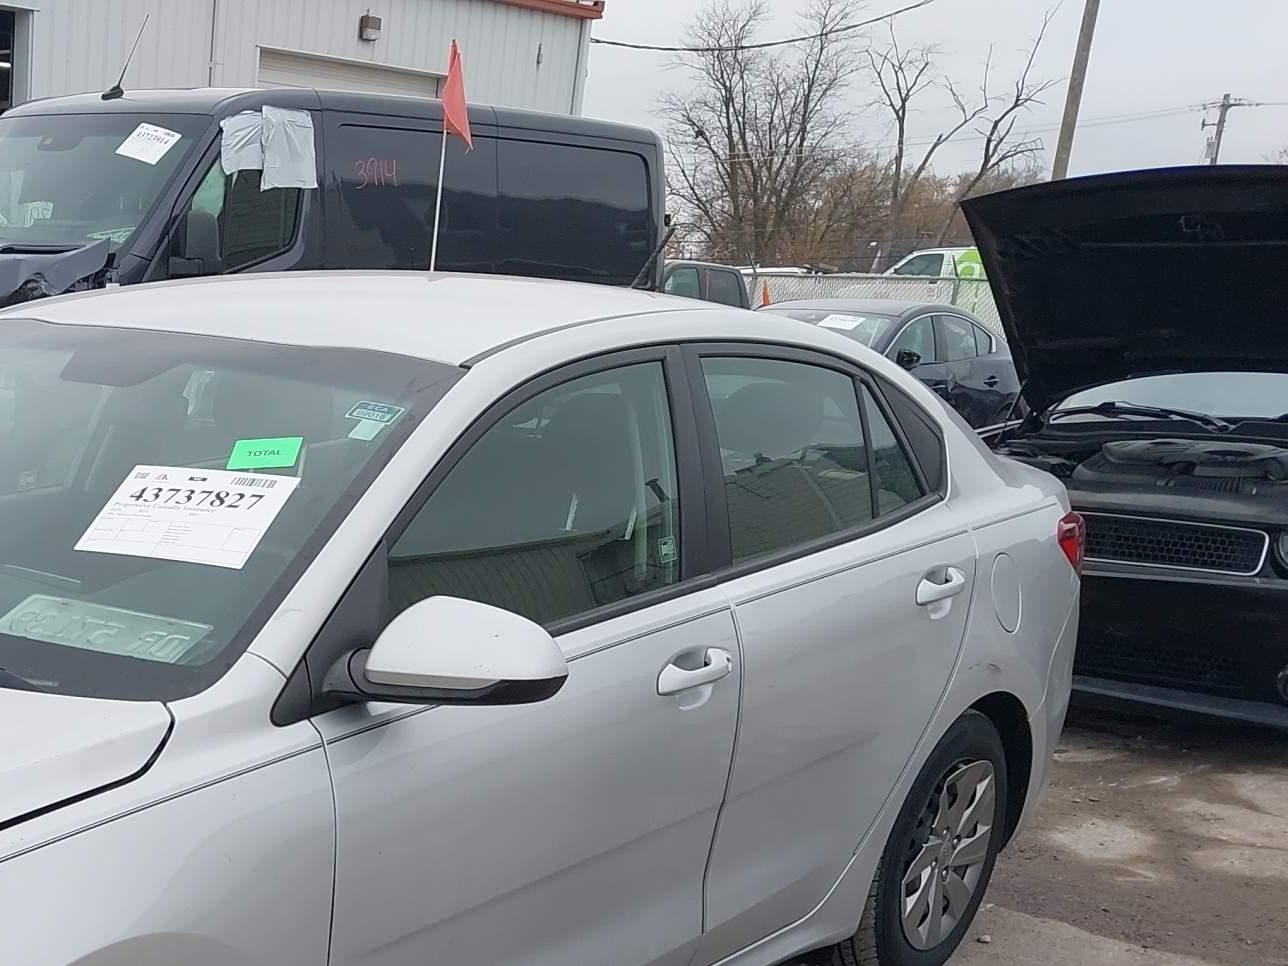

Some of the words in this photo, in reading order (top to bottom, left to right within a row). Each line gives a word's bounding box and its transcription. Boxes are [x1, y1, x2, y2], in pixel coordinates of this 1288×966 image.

[354, 157, 398, 189] 3914
[247, 449, 282, 457] TOTAL
[129, 486, 266, 511] 43737827
